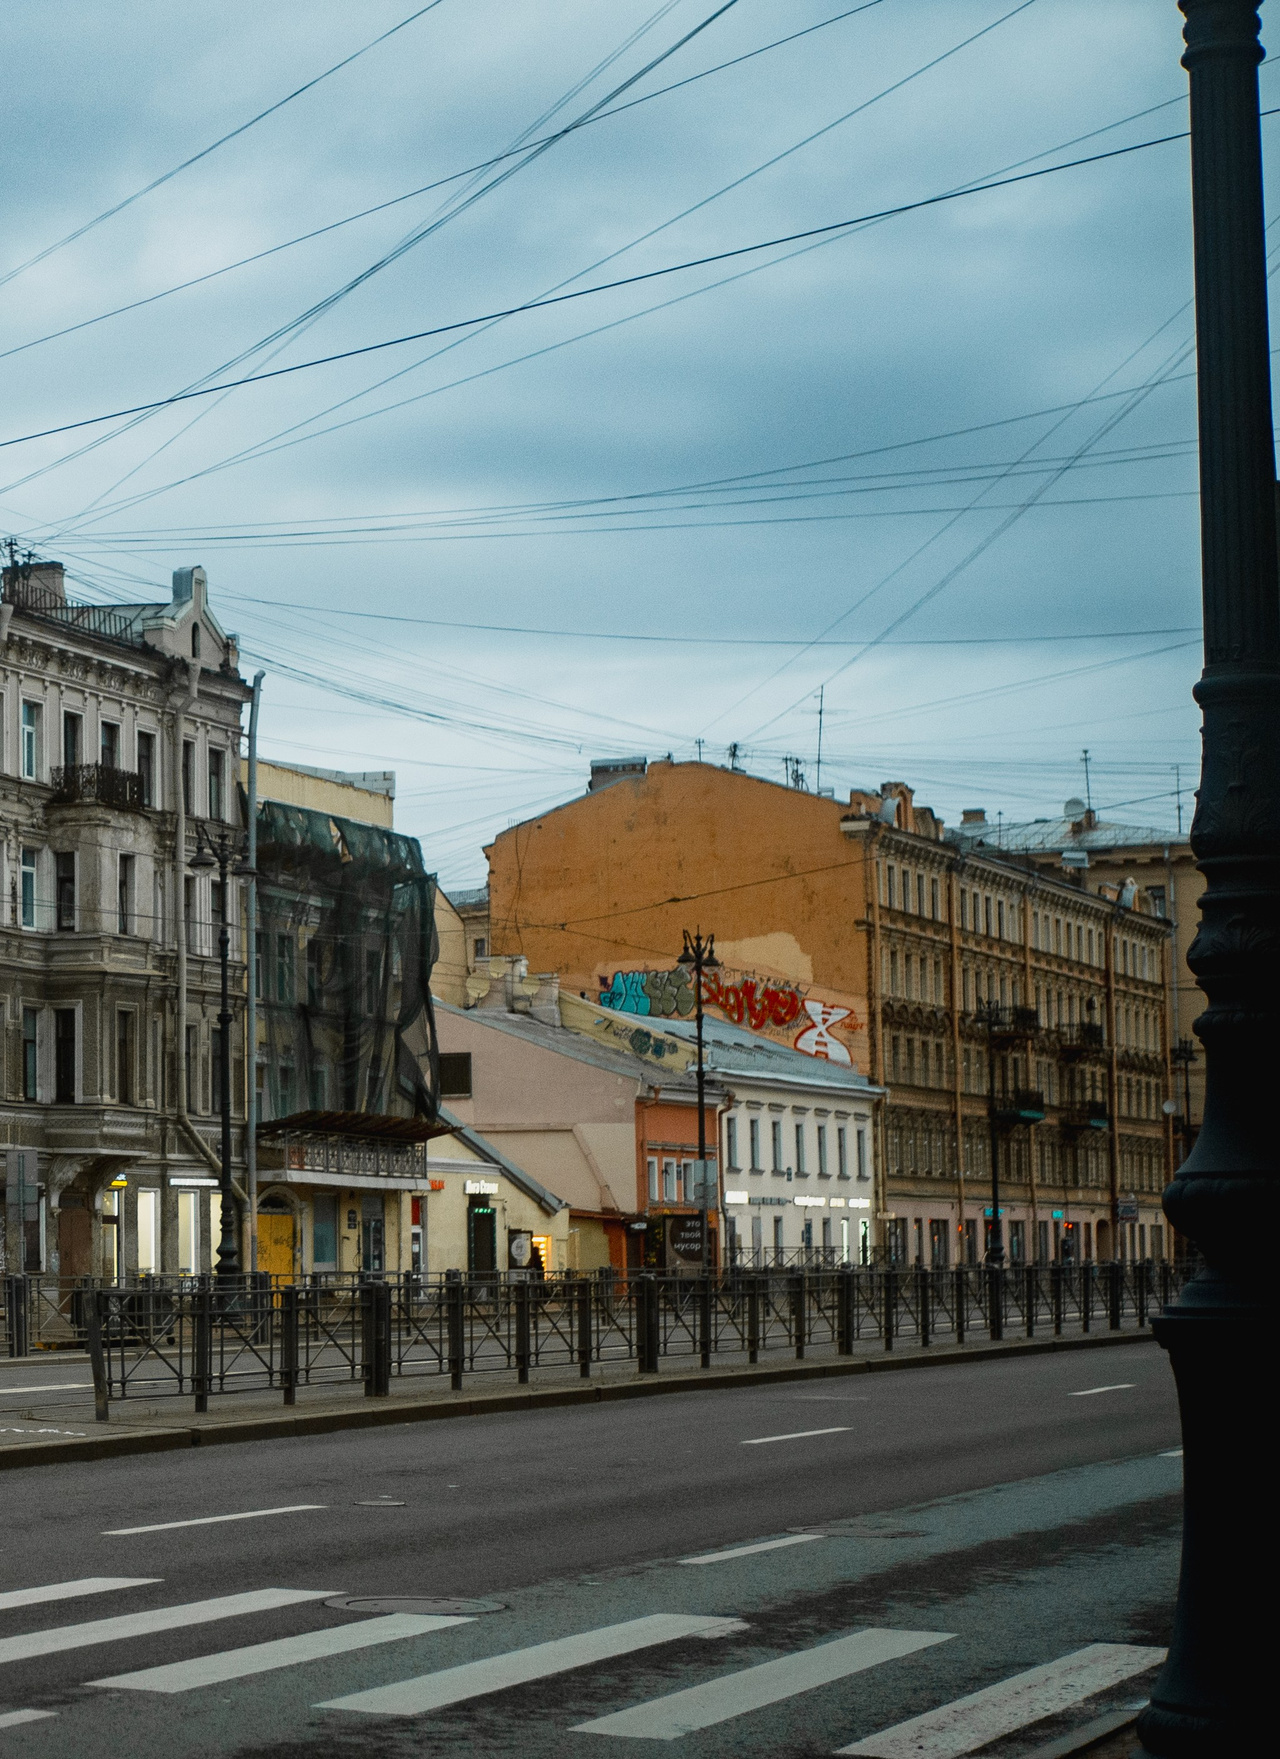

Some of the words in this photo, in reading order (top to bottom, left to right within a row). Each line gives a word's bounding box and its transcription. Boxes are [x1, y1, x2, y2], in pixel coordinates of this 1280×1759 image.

[686, 1220, 701, 1228] это
[680, 1230, 701, 1239] твой
[674, 1242, 701, 1251] мусор
